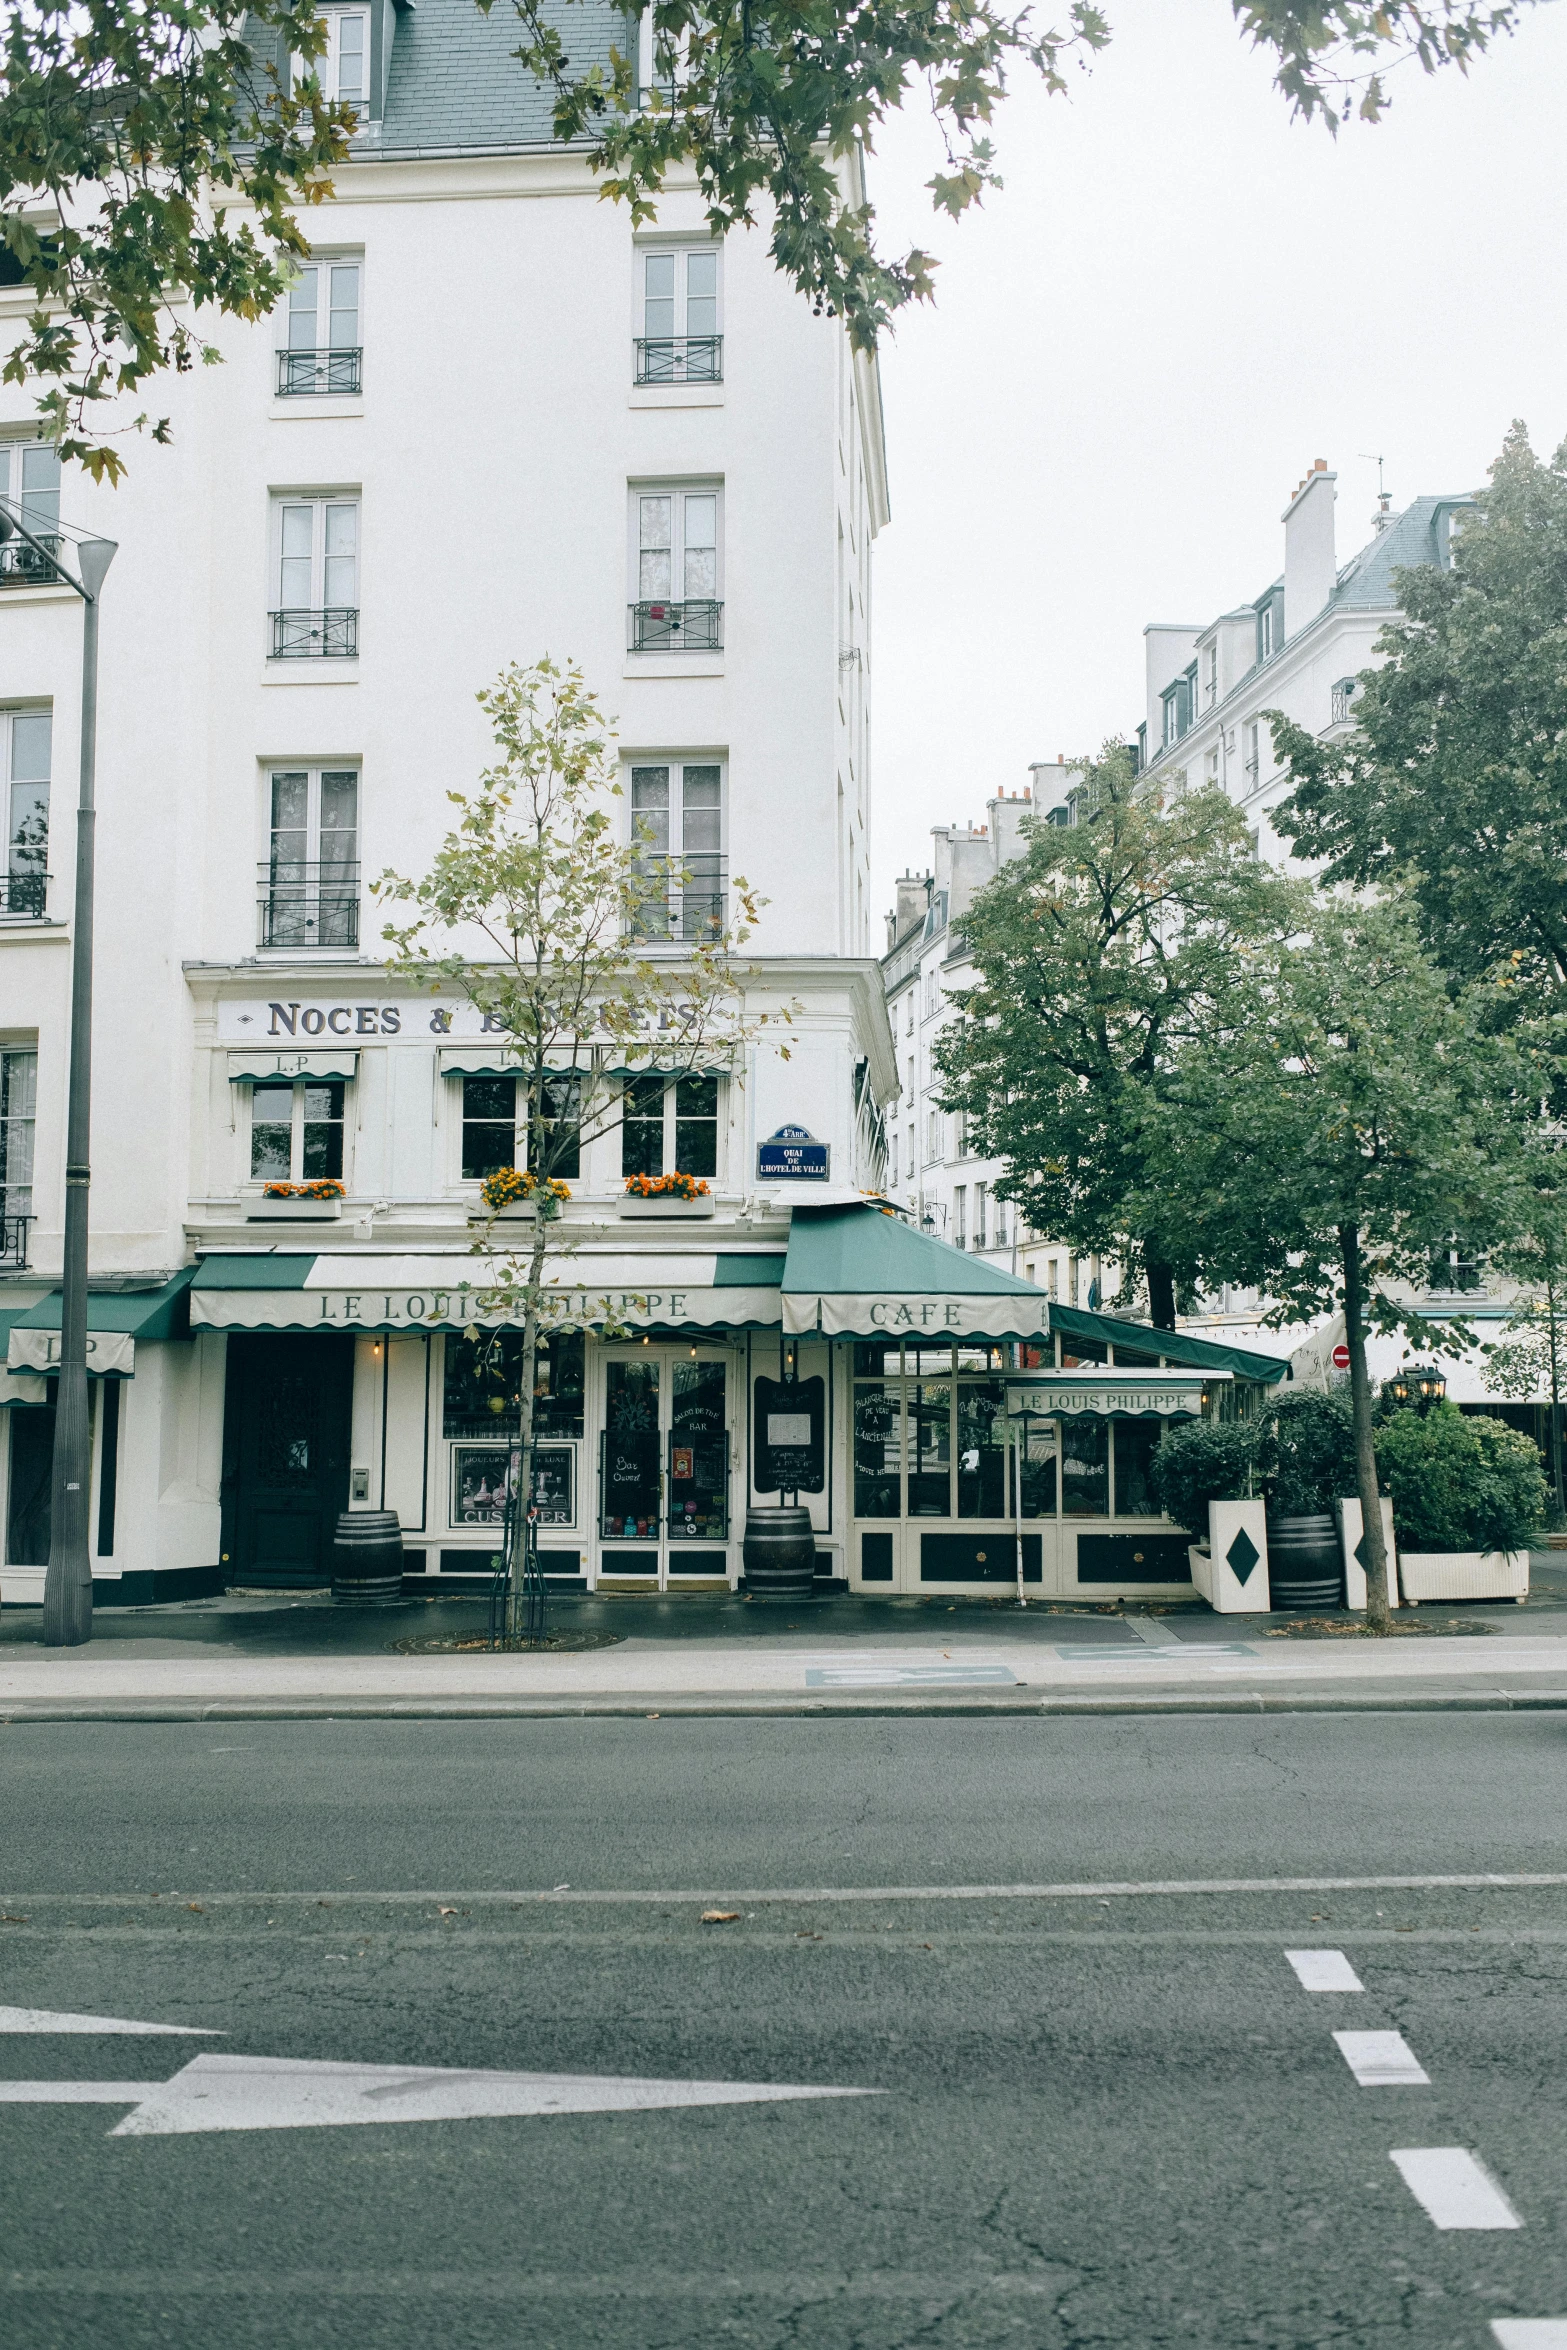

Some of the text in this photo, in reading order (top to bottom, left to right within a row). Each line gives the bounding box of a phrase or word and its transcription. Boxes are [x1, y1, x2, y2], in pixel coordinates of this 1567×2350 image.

[267, 1003, 402, 1035] NOCES
[429, 1007, 451, 1034] &
[276, 1056, 308, 1072] L.P
[783, 1149, 803, 1158] QUAI
[803, 1165, 826, 1173] VILLE
[320, 1296, 362, 1319] LE
[384, 1295, 492, 1319] LOUIS
[869, 1303, 962, 1326] CAFE
[1020, 1394, 1188, 1409] LE LOUIS PHILIPPE
[674, 1408, 694, 1424] SALON
[875, 1407, 890, 1415] VEAU
[689, 1423, 708, 1431] BAR
[616, 1456, 638, 1470] Bar
[613, 1473, 641, 1482] Ouvert
[464, 1510, 568, 1523] CUSER
